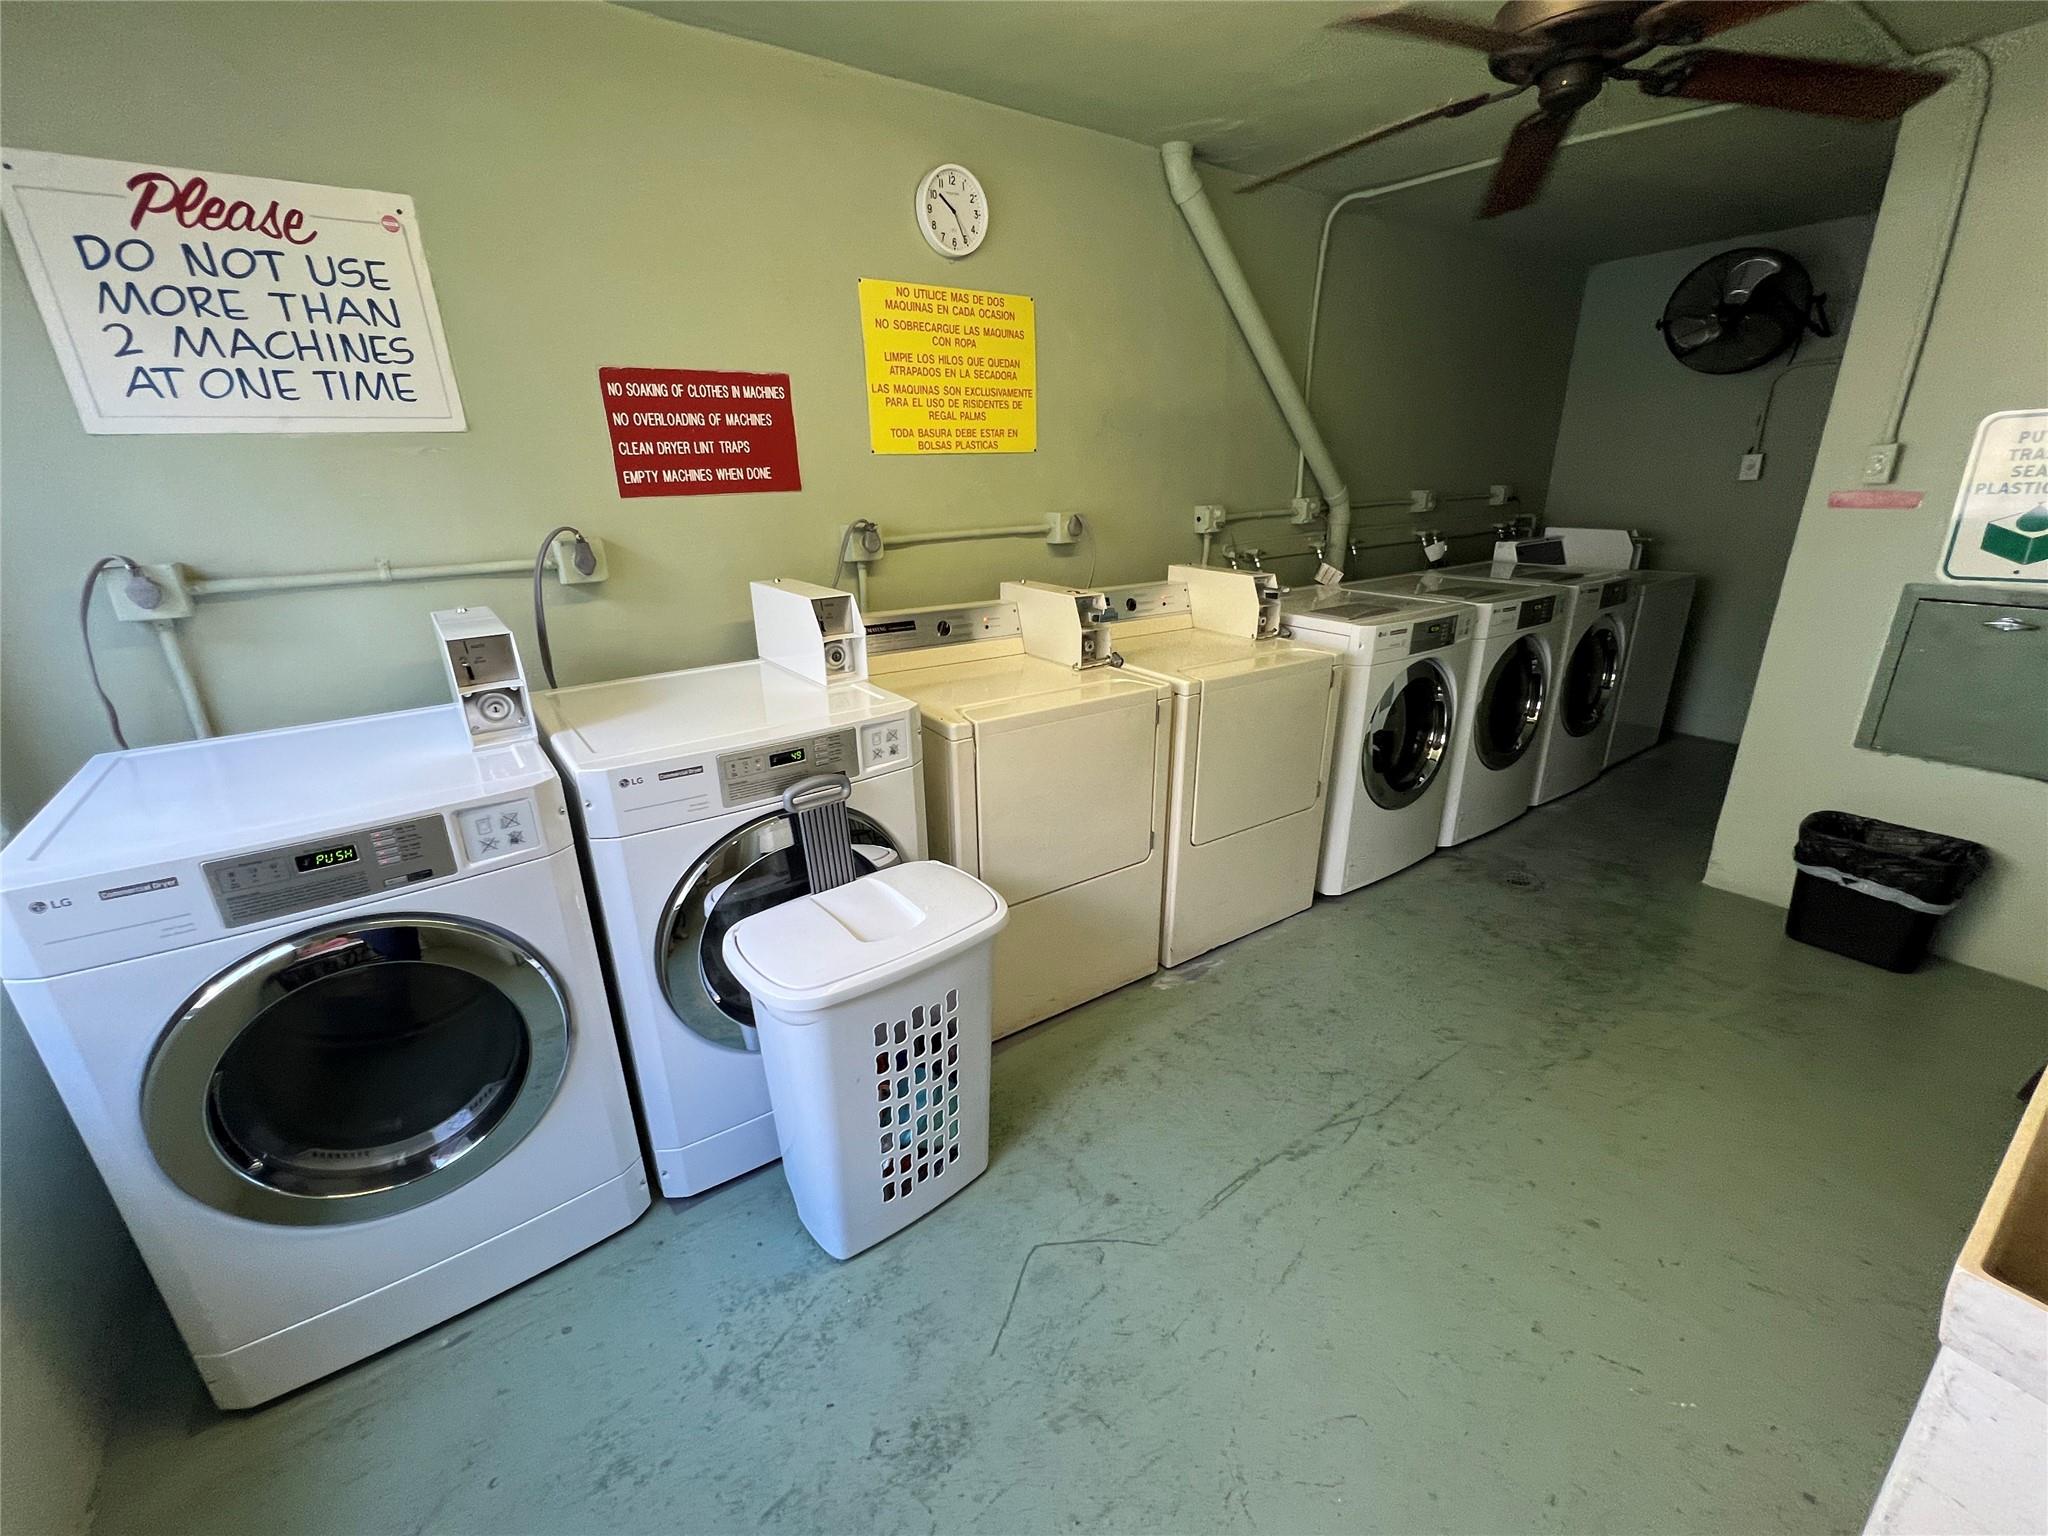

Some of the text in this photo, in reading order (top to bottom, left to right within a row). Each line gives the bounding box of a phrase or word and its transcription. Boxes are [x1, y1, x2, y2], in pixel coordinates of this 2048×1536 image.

[939, 179, 944, 189] 11
[949, 175, 956, 185] 12
[962, 182, 965, 191] 1
[930, 190, 937, 199] 10
[970, 194, 975, 204] 2
[126, 171, 317, 245] Please
[927, 204, 932, 213] 9
[974, 210, 979, 219] 3
[932, 221, 936, 230] 8
[971, 225, 975, 234] 4
[941, 232, 946, 241] 7
[952, 238, 957, 247] 6
[73, 234, 391, 291] DO NOT USE
[896, 287, 1005, 308] NO UTILICE MAS DE DOS
[99, 282, 401, 329] MORE THAN
[885, 300, 1015, 321] MAQUINAS EN CADA OCASION
[875, 319, 1025, 340] NO SOBRECARGUE LAS MAQUINAS
[101, 323, 415, 365] 2 MACHINES
[932, 336, 976, 348] CON ROPA
[884, 352, 1020, 368] LIMPIE LOS HILOS QUE QUEDAN
[890, 366, 1017, 380] ATRAPADOS EN LA SECADORA
[126, 366, 418, 403] AT ONE TIME
[607, 382, 785, 400] NO SOAKING OF CLOTHES IN MACHINES
[872, 384, 1033, 398] LAS MAQUINAS SON EXCLUSIVAMENTE
[886, 397, 1023, 409] PARA EL USO DE RISIDENTES DE
[613, 413, 772, 426] NO OVERLOADING OF MACHINES
[929, 411, 986, 421] REGAL PALMS
[891, 428, 1018, 437] TODA BASURA DEBE ESTAR EN
[2018, 431, 2048, 444] PU
[619, 441, 751, 455] CLEAN DRYER LINT TRAPS
[918, 441, 999, 450] BOLSAS PLASTICAS
[2009, 448, 2048, 461] TRA
[623, 467, 772, 484] EMPTY MACHINES WHEN DONE
[631, 777, 644, 785] LG
[316, 849, 353, 866] PUSH
[50, 897, 73, 910] LG
